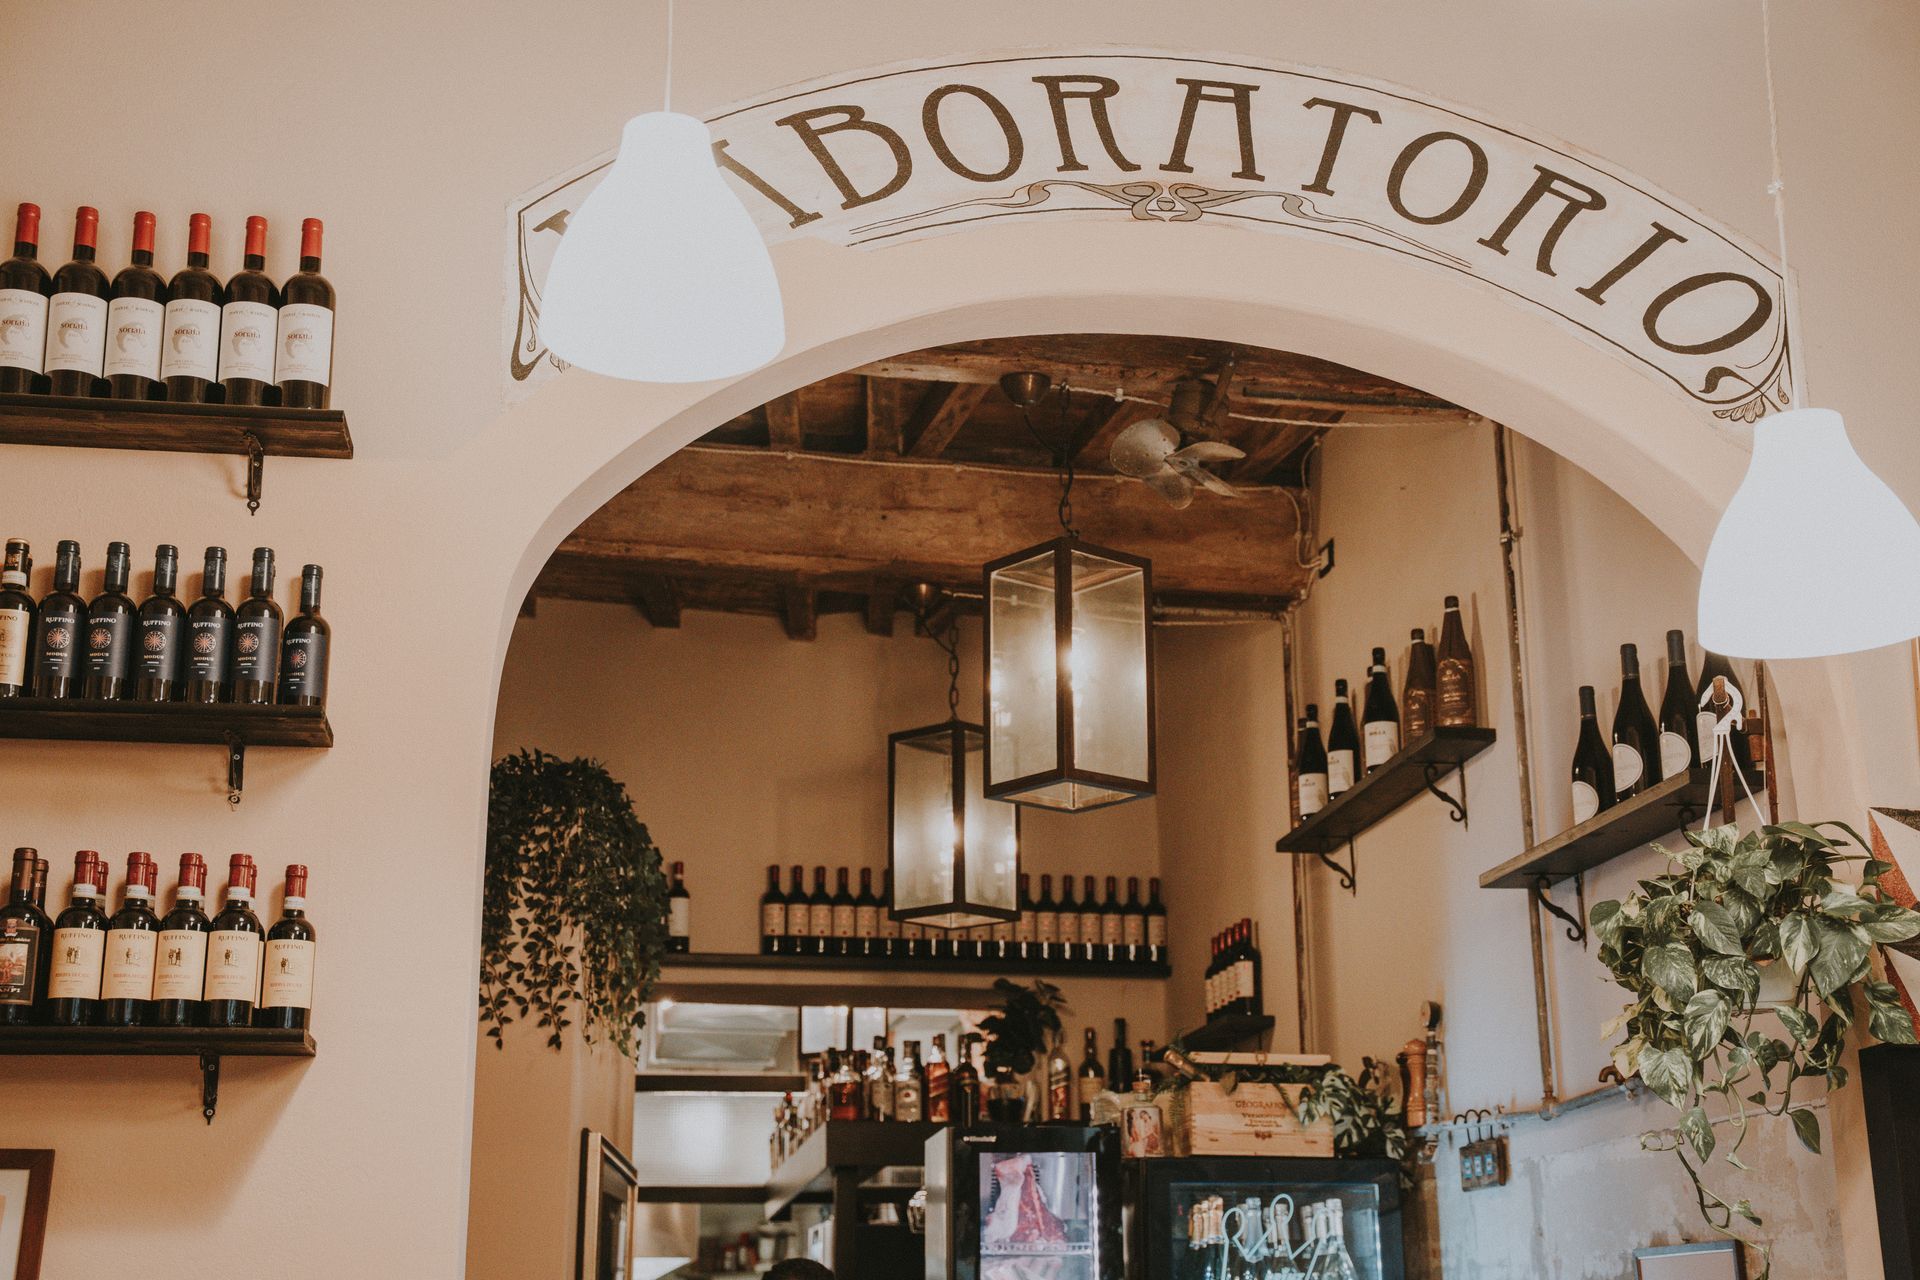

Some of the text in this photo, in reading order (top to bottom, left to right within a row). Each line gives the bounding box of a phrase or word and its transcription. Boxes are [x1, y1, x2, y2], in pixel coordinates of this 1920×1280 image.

[532, 74, 1773, 355] BORATORIO
[45, 616, 75, 624] RUFFINO
[89, 617, 117, 625] RUFFINO
[143, 620, 171, 628] RUFFINO
[192, 621, 221, 629] RUFFINO
[237, 621, 264, 629] RUFFINO
[60, 932, 92, 941] RUFFINO
[118, 933, 150, 941] RUFFINO
[162, 934, 193, 942] RUFFINO
[274, 943, 304, 951] RUFFINO
